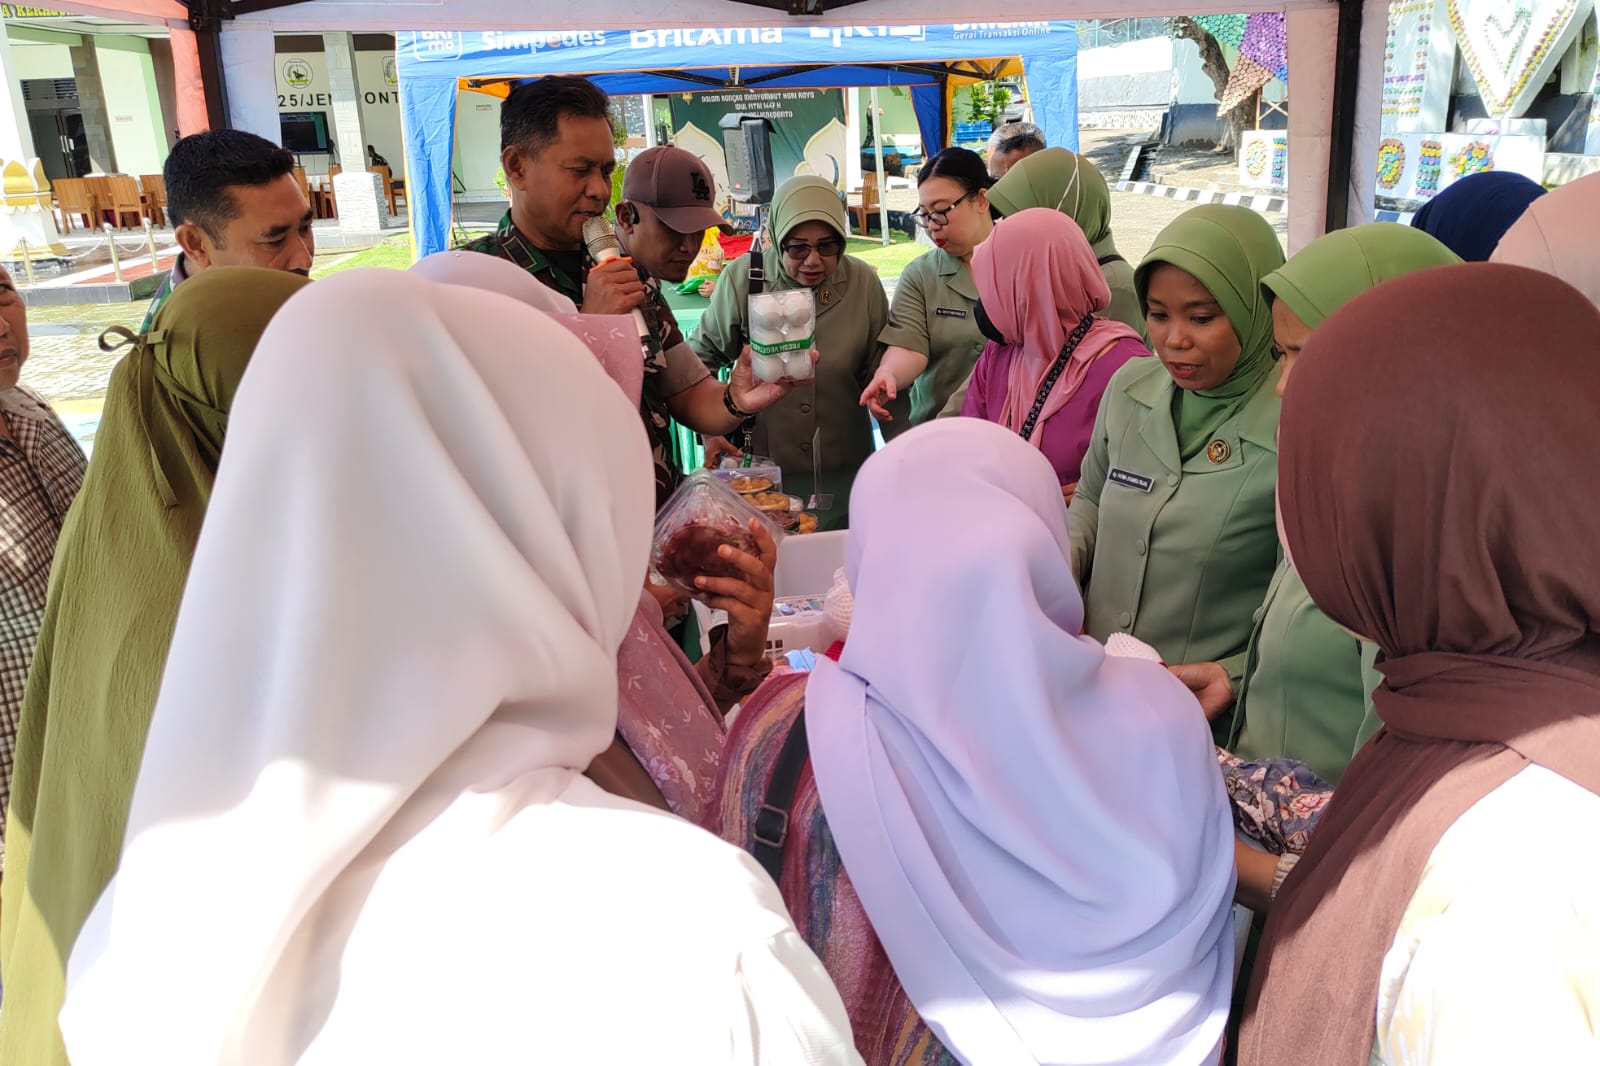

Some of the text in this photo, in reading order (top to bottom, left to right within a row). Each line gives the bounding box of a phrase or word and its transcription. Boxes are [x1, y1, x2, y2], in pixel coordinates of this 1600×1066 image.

[953, 31, 977, 40] Gerai
[980, 28, 1020, 39] Transaksi
[1022, 26, 1051, 36] Online
[481, 30, 607, 54] Simpedes
[780, 342, 800, 352] FRESH
